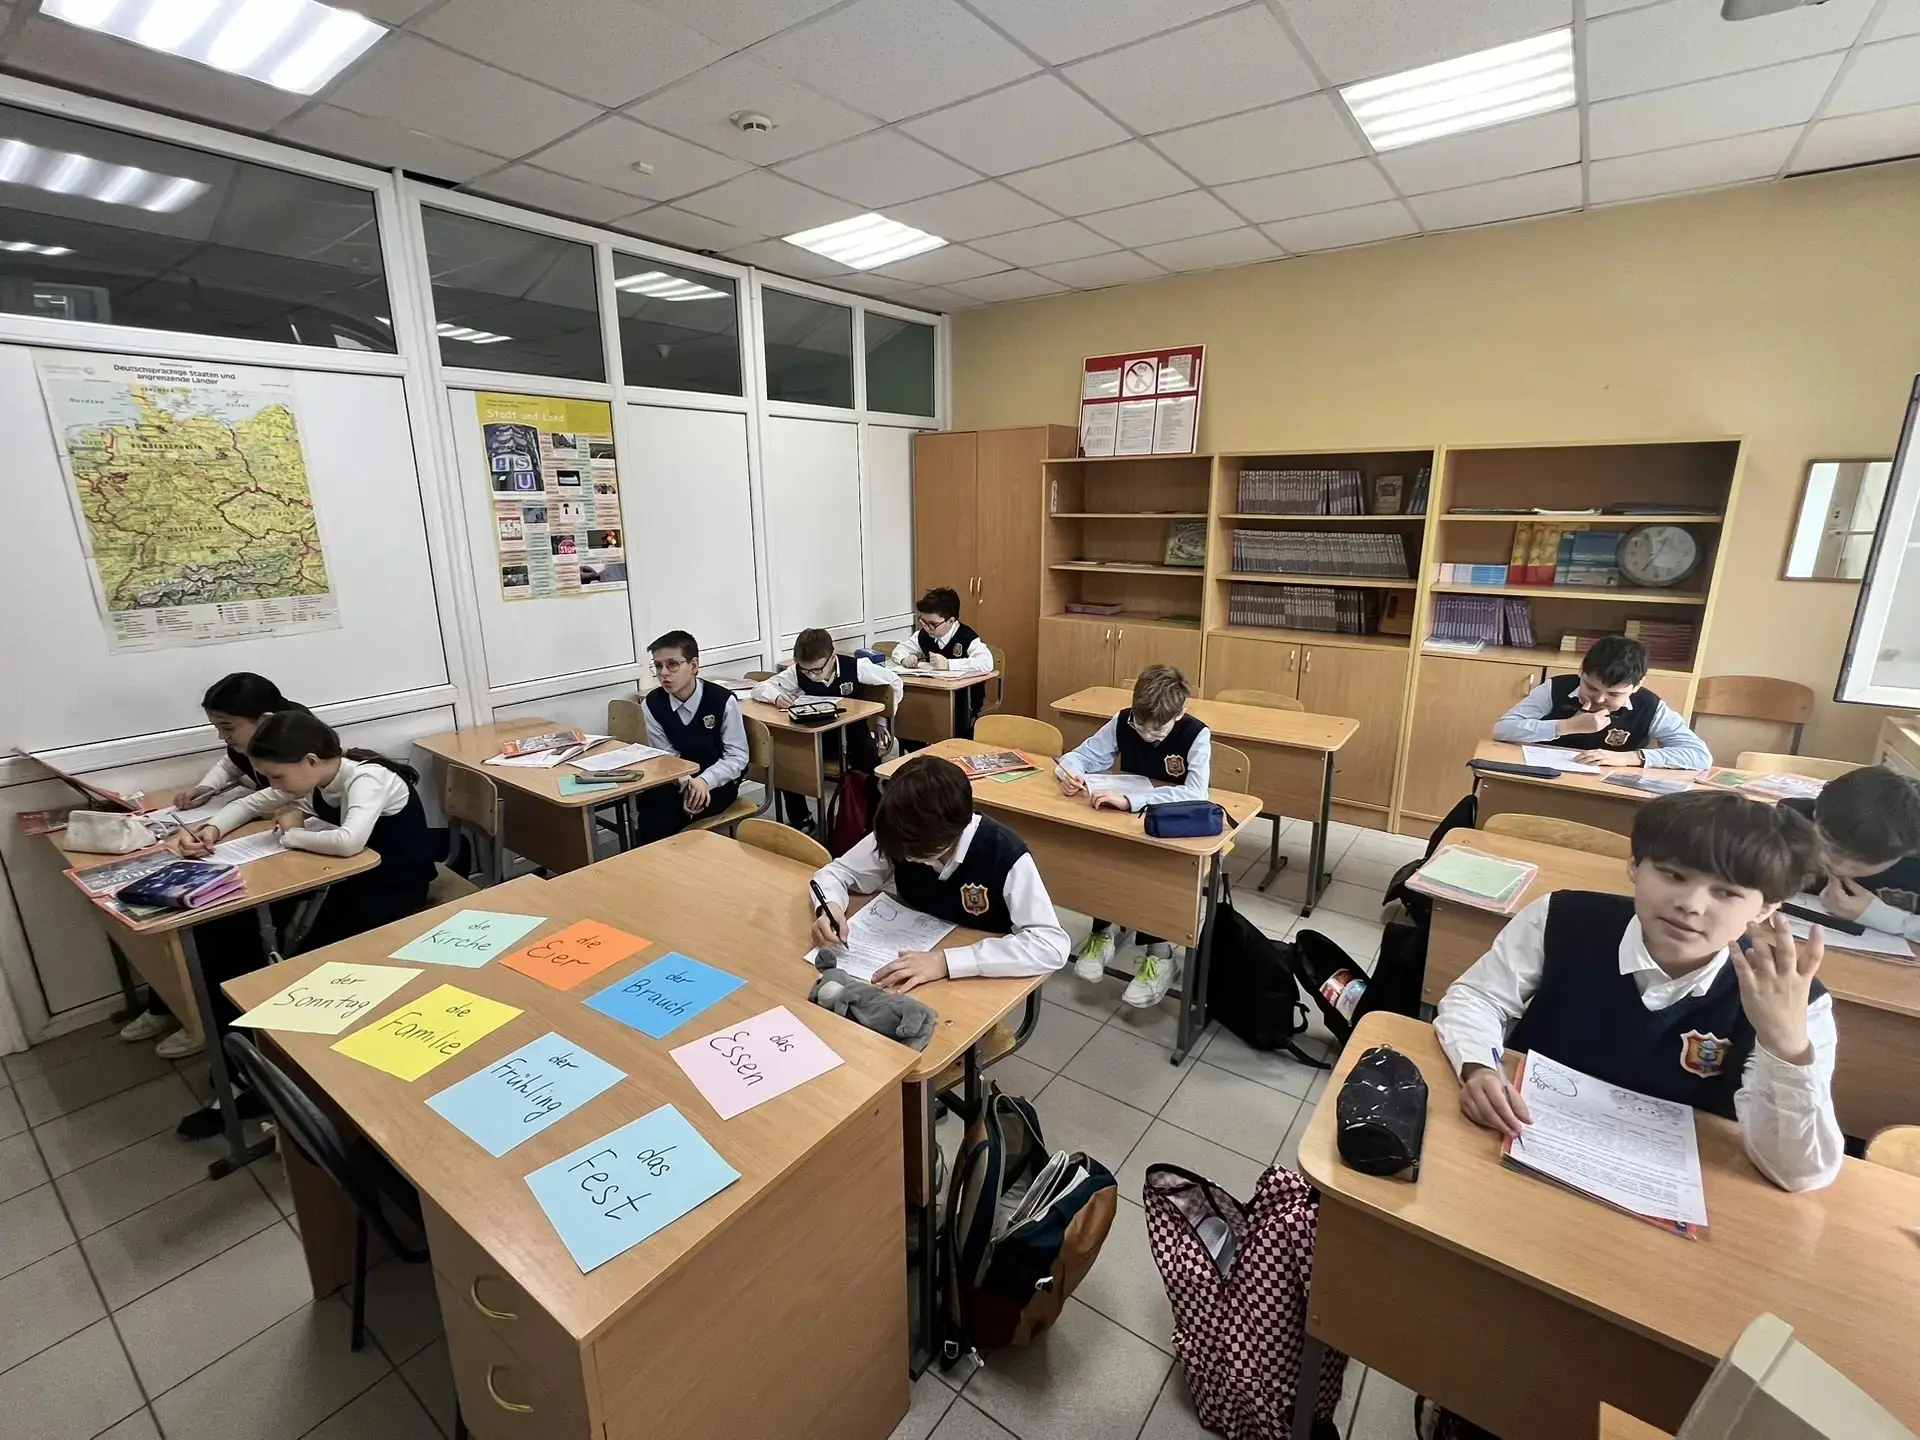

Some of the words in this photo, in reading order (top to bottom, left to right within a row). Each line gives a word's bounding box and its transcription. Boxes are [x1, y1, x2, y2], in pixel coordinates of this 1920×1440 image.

[113, 364, 188, 376] Deutschsprachige
[188, 370, 219, 378] Staaten
[137, 373, 191, 383] angrenzende
[486, 409, 517, 419] Stadt
[520, 412, 539, 421] und
[542, 413, 565, 422] Land
[518, 474, 532, 489] U
[559, 545, 577, 554] STOP
[468, 919, 491, 931] die
[420, 928, 492, 952] Kirche
[575, 934, 602, 949] die
[526, 939, 592, 968] Eier
[330, 973, 367, 986] der
[665, 970, 696, 984] der
[272, 987, 372, 1019] Sonntag
[621, 978, 686, 1017] Brauch
[445, 1001, 472, 1018] die
[377, 1011, 463, 1056] Familie
[769, 1032, 795, 1053] das
[548, 1052, 580, 1070] der
[709, 1030, 765, 1087] Essen
[490, 1057, 563, 1123] Frühling
[637, 1145, 678, 1178] das
[567, 1148, 653, 1220] Fest
